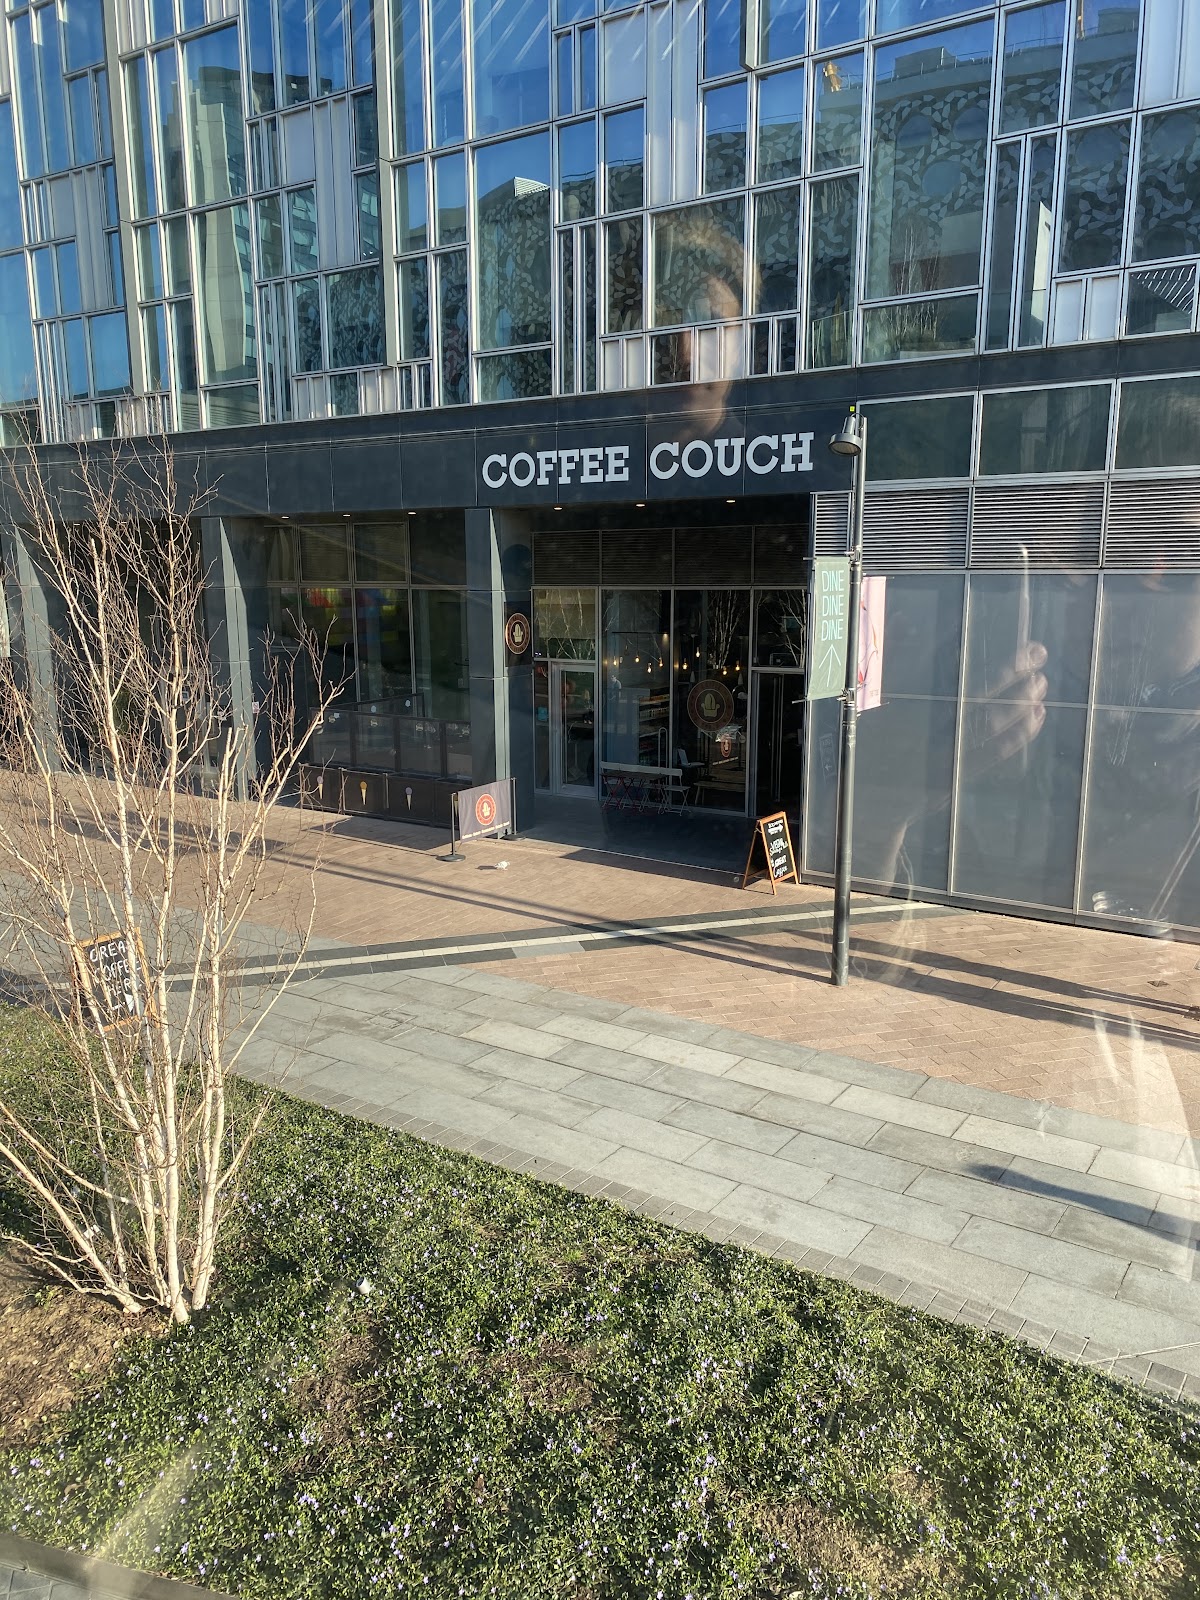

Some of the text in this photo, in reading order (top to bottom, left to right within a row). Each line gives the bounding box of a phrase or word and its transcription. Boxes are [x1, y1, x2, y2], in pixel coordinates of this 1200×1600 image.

[482, 432, 815, 488] COFFEE COUCH
[821, 570, 845, 592] DINE
[822, 594, 844, 617] DINE
[821, 618, 844, 642] DINE
